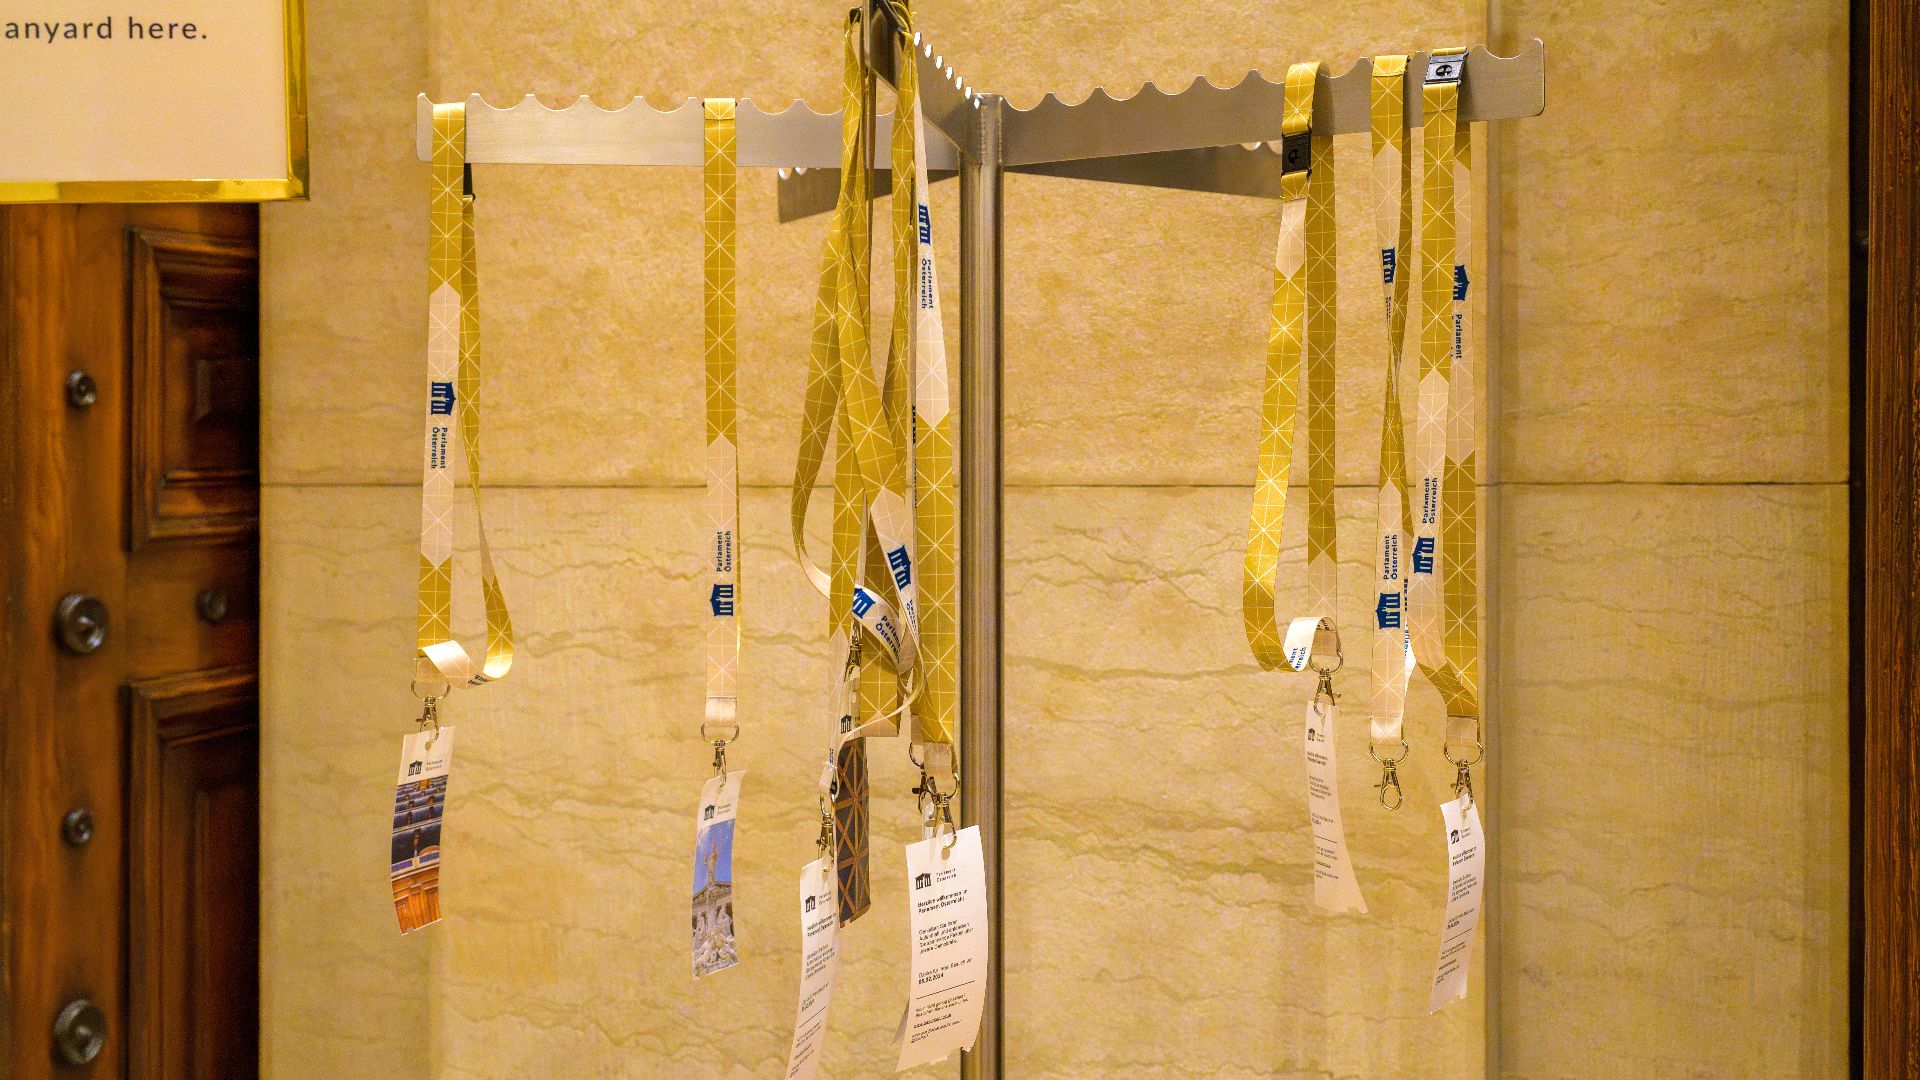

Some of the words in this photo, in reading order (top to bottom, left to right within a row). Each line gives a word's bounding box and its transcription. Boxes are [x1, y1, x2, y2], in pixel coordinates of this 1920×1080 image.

[5, 16, 112, 44] anyard
[128, 16, 207, 40] here.
[1455, 313, 1463, 359] Parlament
[431, 426, 440, 469] Österreich
[440, 426, 448, 469] Parlament
[1422, 477, 1430, 524] Parlament
[1429, 477, 1438, 524] Österreich
